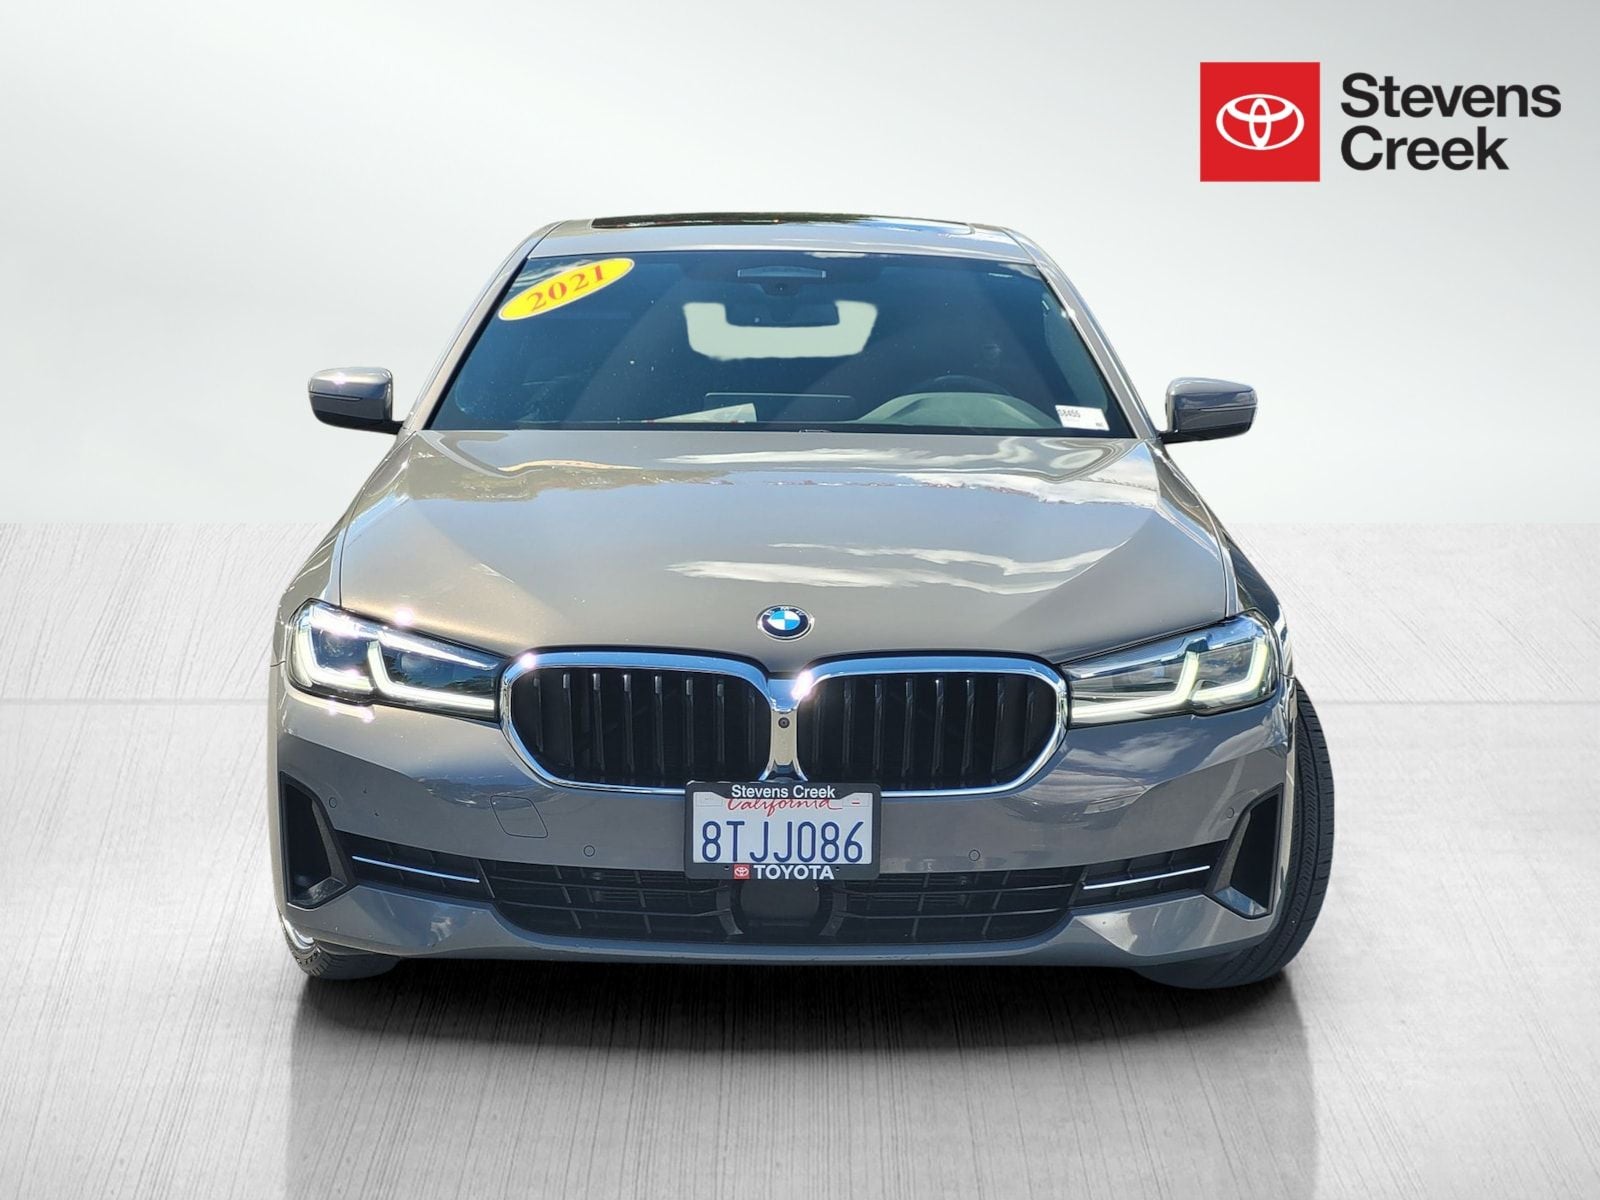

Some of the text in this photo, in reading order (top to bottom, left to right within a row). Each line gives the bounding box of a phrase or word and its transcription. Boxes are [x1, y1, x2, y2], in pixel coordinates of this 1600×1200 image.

[526, 265, 604, 312] 2021
[731, 784, 835, 799] Stevens Creek
[702, 820, 864, 863] 8TJJ086
[753, 864, 835, 880] TOYOTA
